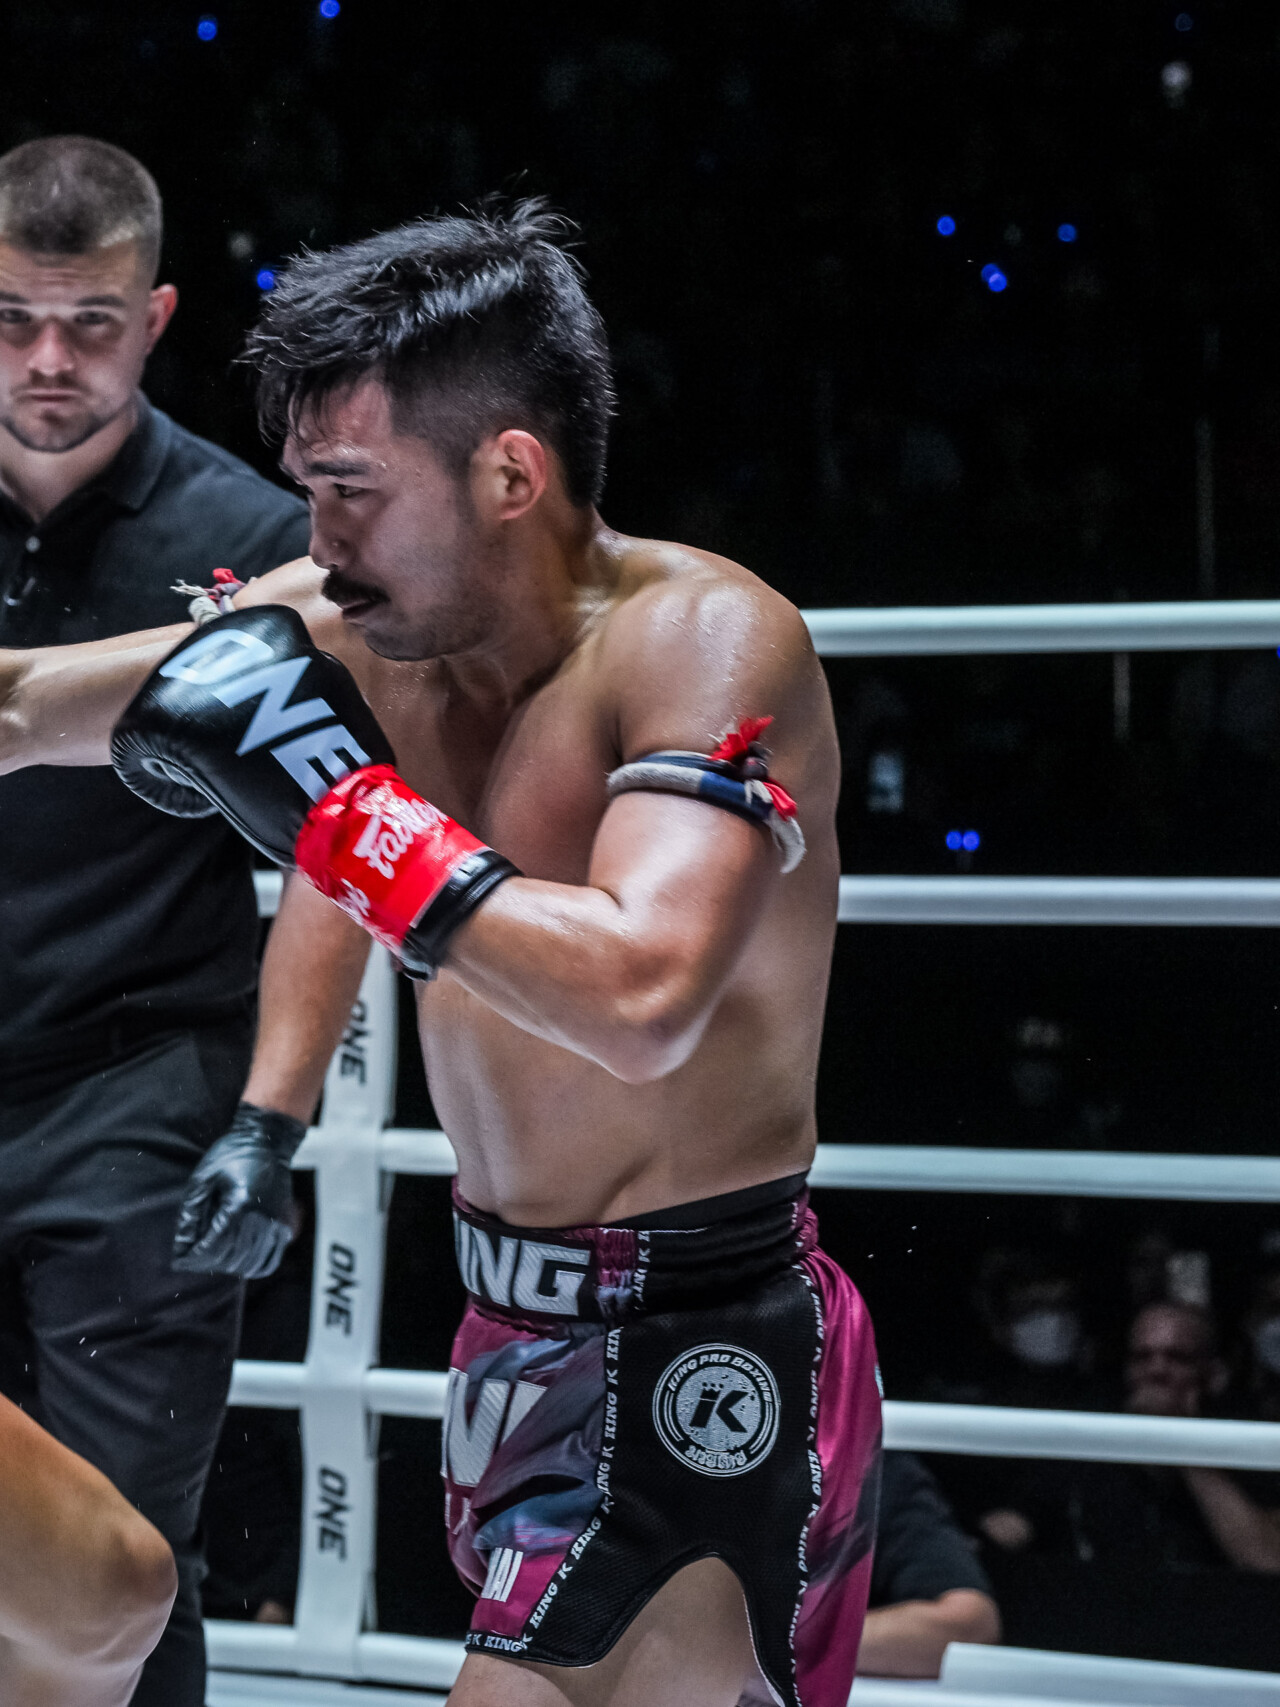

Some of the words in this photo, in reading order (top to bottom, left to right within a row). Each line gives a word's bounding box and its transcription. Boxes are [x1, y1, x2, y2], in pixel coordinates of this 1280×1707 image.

[158, 628, 373, 803] ONE
[452, 1209, 591, 1317] ING
[324, 1242, 359, 1337] ONE
[606, 1368, 619, 1386] K
[667, 1358, 698, 1392] KING
[699, 1353, 732, 1366] PRO
[730, 1356, 774, 1403] BOXING
[604, 1391, 618, 1440] KING
[601, 1446, 616, 1459] K
[314, 1466, 353, 1561] ONE
[570, 1516, 602, 1561] KING
[557, 1562, 573, 1580] K
[529, 1582, 559, 1630] KING
[484, 1635, 523, 1653] KING
